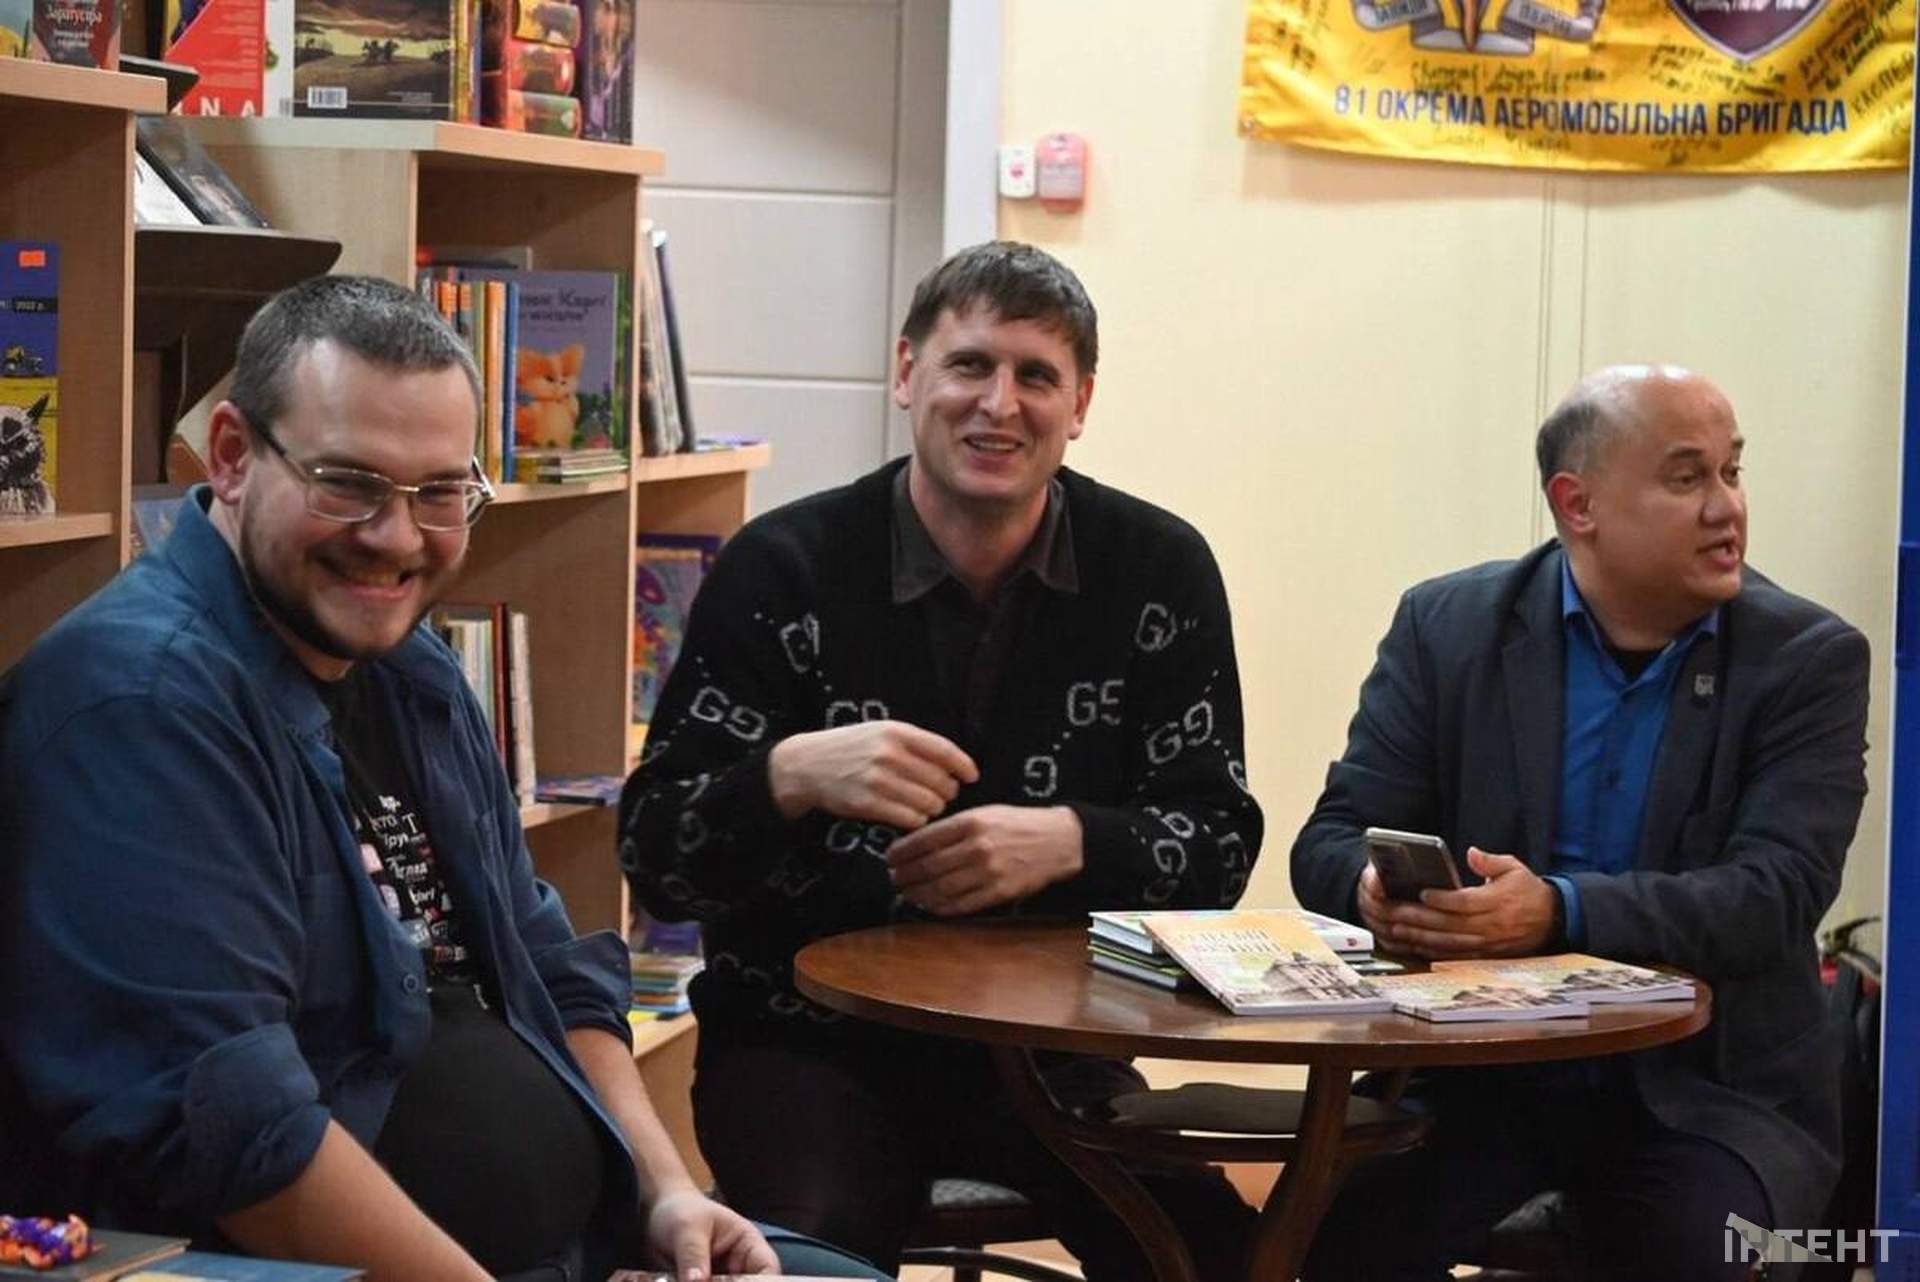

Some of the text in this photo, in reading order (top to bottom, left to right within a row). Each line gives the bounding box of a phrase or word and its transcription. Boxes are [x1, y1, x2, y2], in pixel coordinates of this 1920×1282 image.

[1334, 83, 1847, 136] 81 ОКРЕМА АЕРОМОБІЛЬНА БРИГАДА
